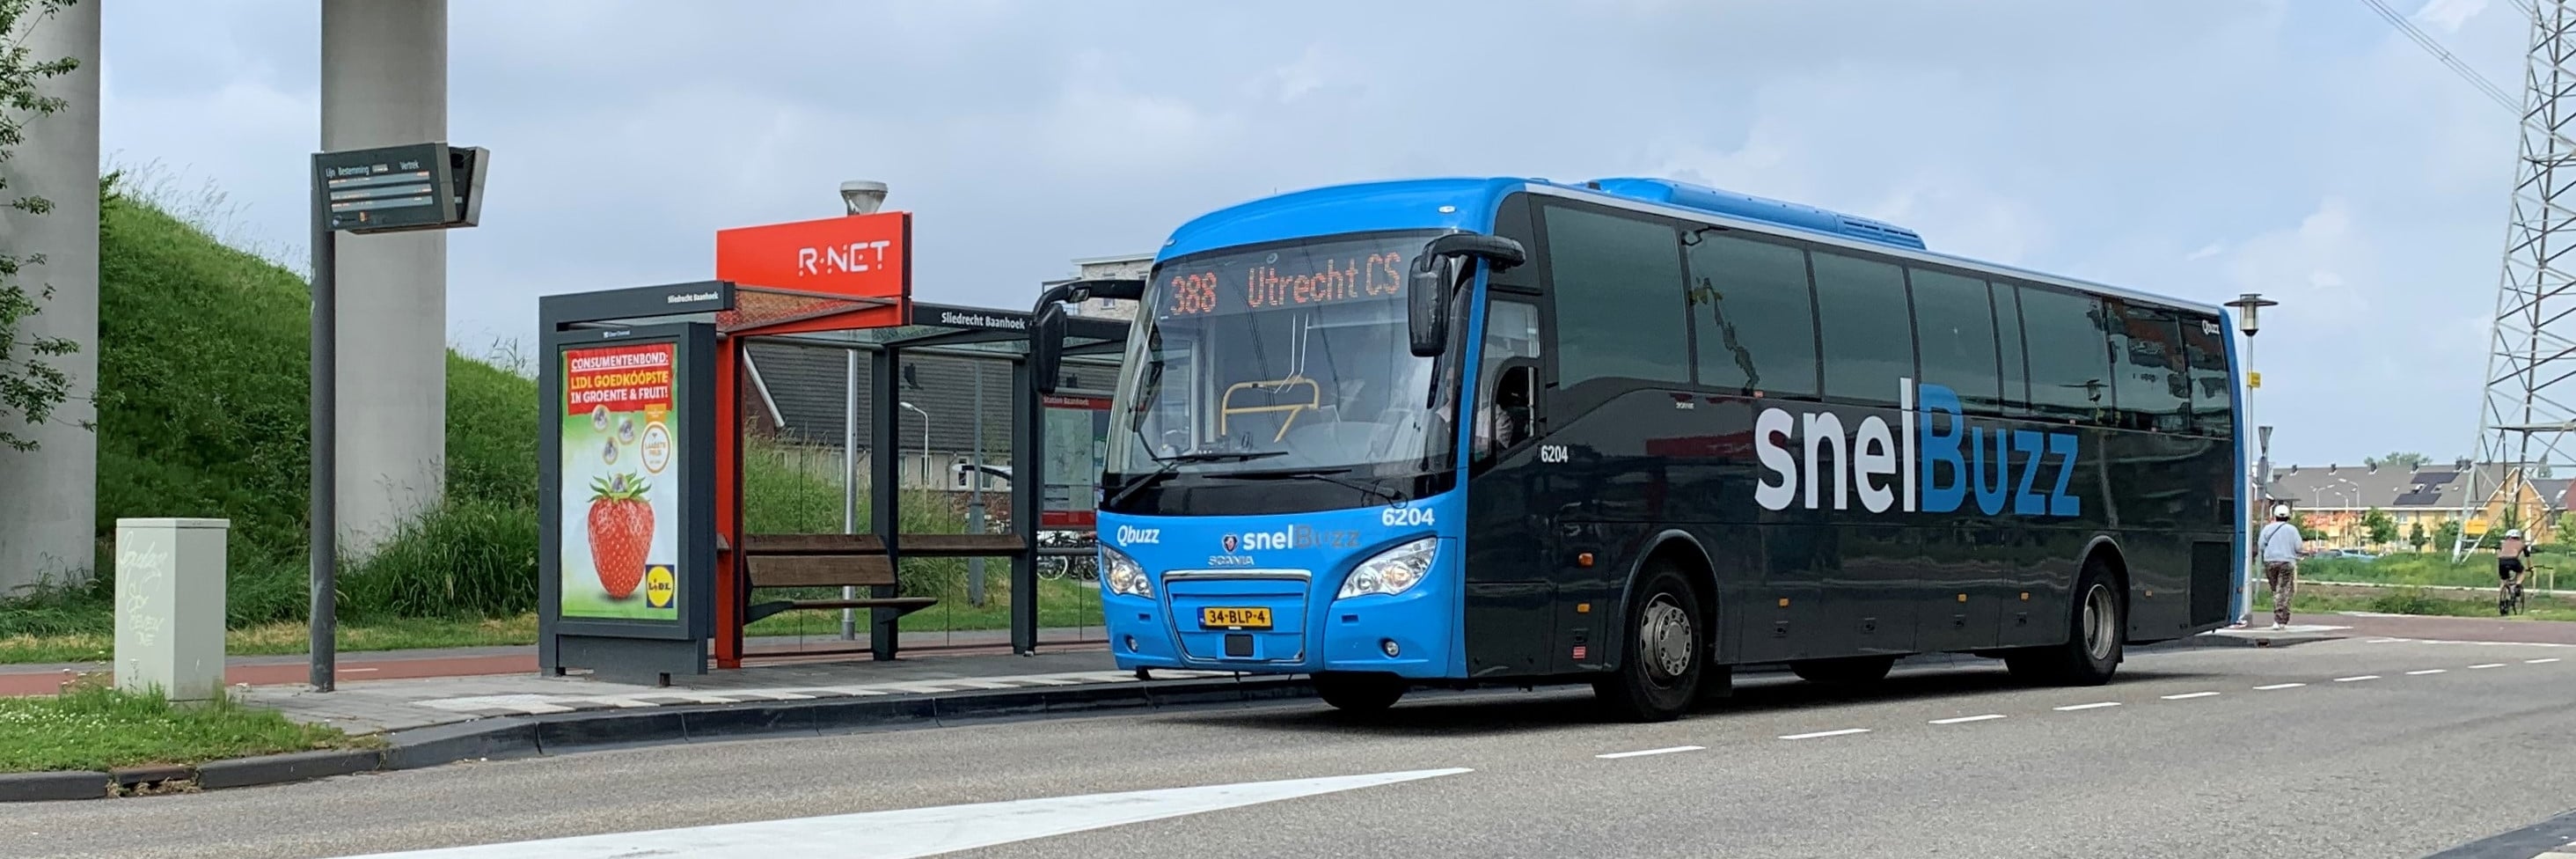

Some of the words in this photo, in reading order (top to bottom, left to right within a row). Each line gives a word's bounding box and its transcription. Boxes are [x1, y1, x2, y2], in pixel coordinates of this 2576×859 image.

[326, 167, 336, 178] Lijn
[338, 165, 370, 175] Bestemming
[399, 159, 420, 170] Vertrek
[1170, 271, 1217, 315] 388
[1248, 258, 1358, 308] Utrecht
[1365, 252, 1401, 296] CS
[668, 293, 692, 304] Sliedrecht
[693, 291, 719, 301] Baanhoek
[941, 312, 984, 327] Sliedrecht
[984, 316, 1025, 329] Baanhoek
[571, 352, 669, 370] CONSUMENTENBOND:
[571, 376, 592, 390] LIDL
[571, 392, 582, 404] IN
[582, 388, 627, 402] GROENTE
[629, 388, 637, 400] &
[638, 385, 669, 400] FRUIT!
[1541, 444, 1569, 463] 6204
[1754, 377, 2081, 518] snelBuzz
[1381, 508, 1435, 527] 6204
[1117, 525, 1160, 547] Qbuzz
[1208, 555, 1255, 565] SCANIA
[1209, 609, 1265, 624] 34-BLP-4
